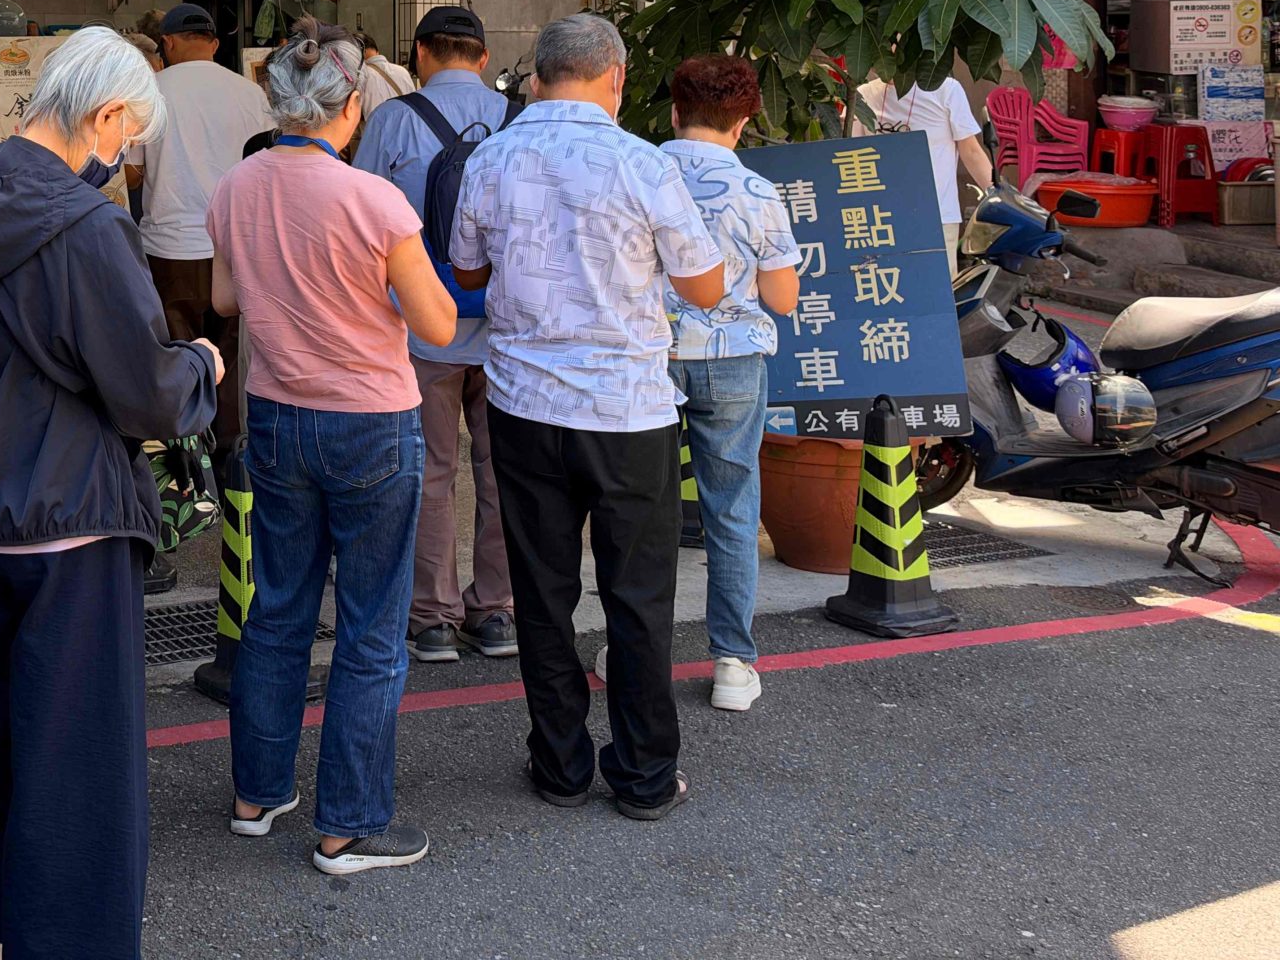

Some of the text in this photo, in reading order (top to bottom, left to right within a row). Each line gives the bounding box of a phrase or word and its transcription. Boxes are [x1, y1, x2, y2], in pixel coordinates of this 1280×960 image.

[775, 179, 845, 393] 請勿停車
[831, 146, 911, 365] 重點取締
[805, 403, 961, 433] 公有車場
